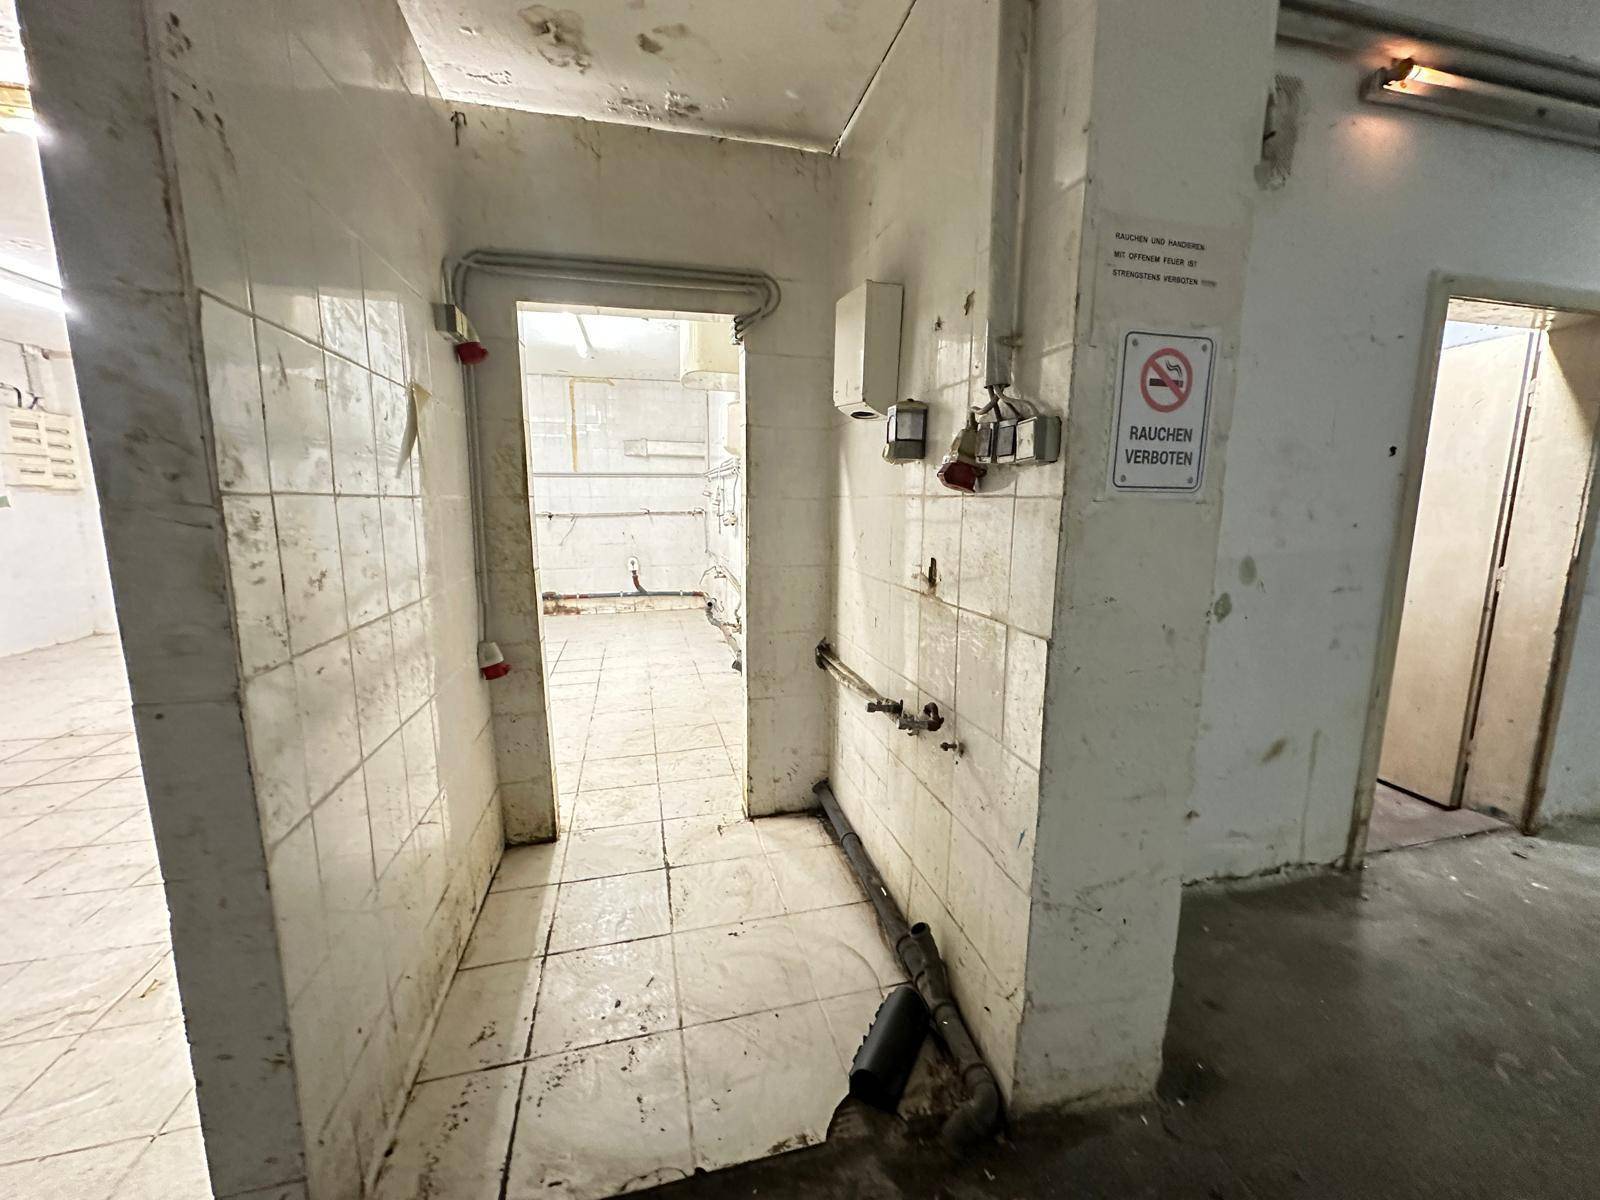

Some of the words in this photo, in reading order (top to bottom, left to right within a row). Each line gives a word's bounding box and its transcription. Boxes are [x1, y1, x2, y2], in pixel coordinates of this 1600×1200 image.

[1115, 232, 1148, 243] RAUCHEN
[1151, 238, 1165, 246] UND
[1129, 252, 1160, 263] OFFENEM
[1163, 257, 1185, 266] FEUER
[1112, 269, 1161, 281] STRENGSTENS
[1163, 275, 1198, 285] VERBOTEN
[1130, 426, 1193, 442] RAUCHEN
[1125, 449, 1193, 465] VERBOTEN
